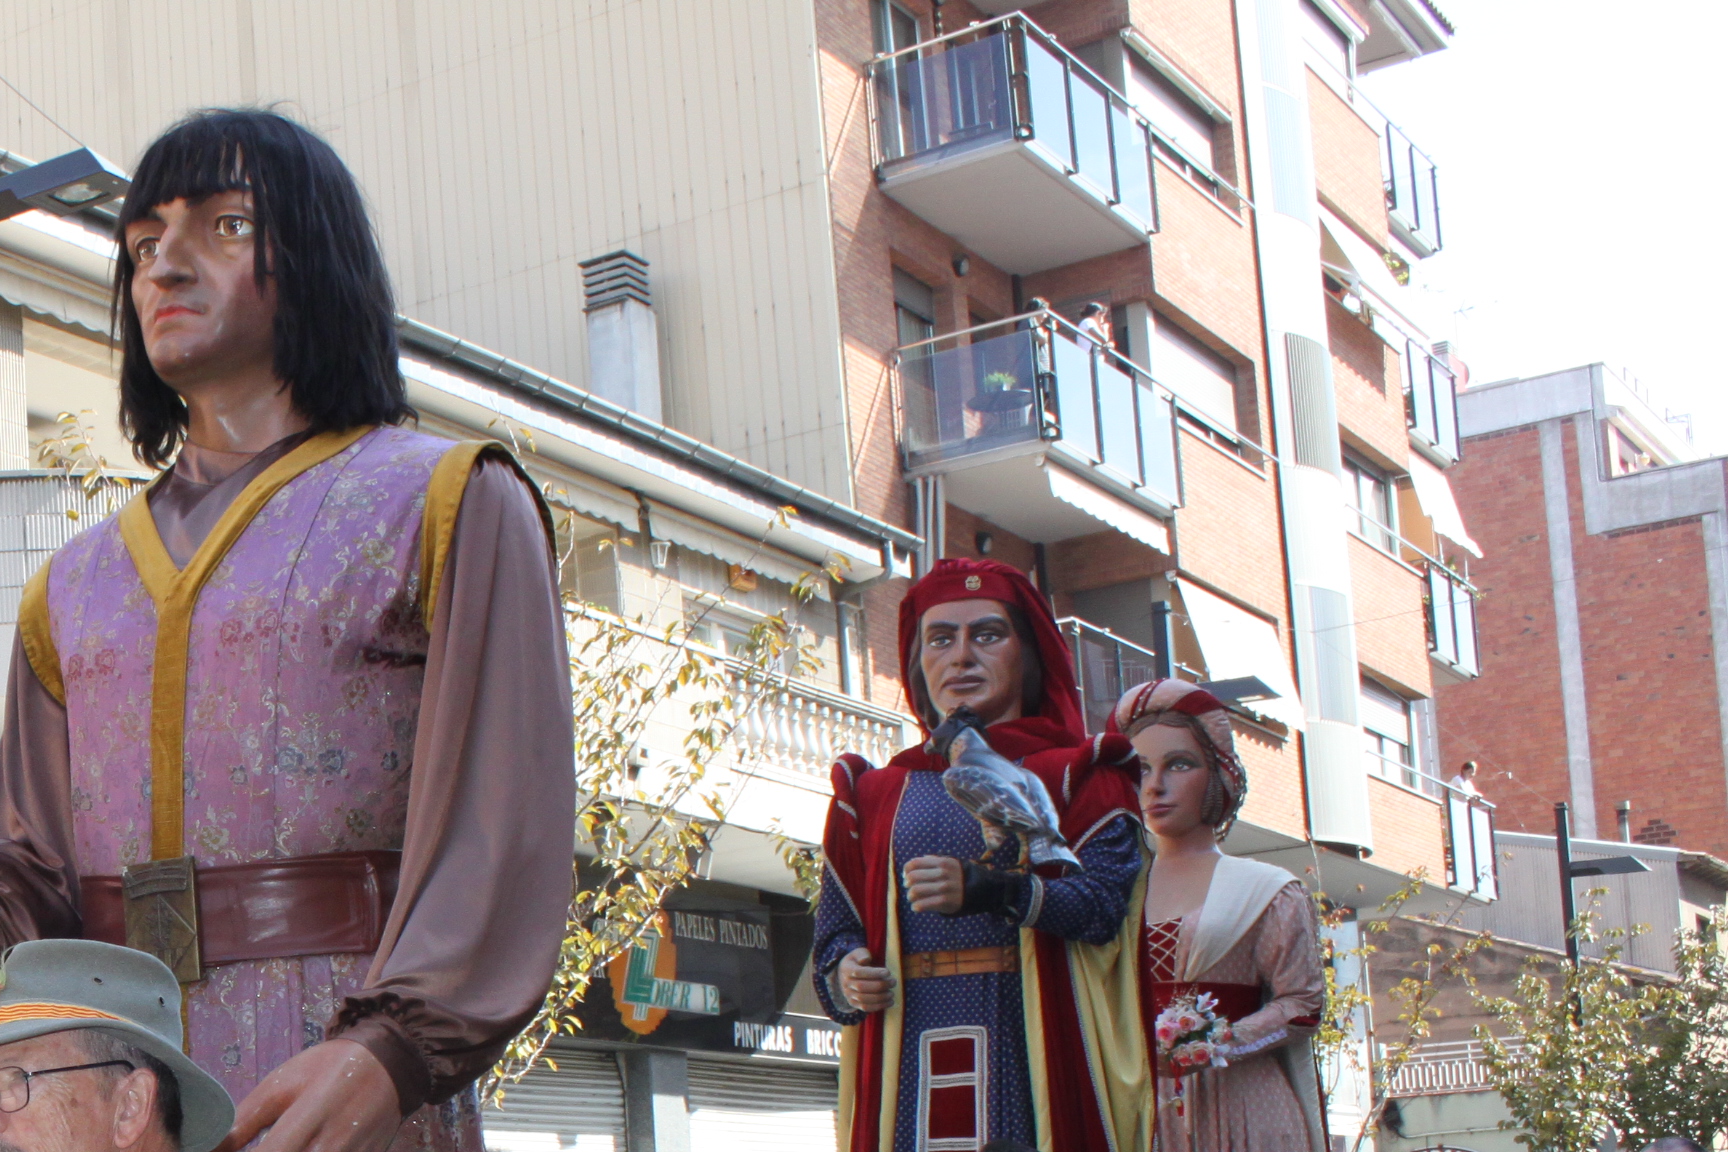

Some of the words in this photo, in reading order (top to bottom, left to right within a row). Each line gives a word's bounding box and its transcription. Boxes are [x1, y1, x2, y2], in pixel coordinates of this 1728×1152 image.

[674, 911, 715, 942] PAPELES
[719, 919, 768, 949] PINTADOS
[702, 985, 719, 1012] 12
[734, 1021, 792, 1052] PINTURAS
